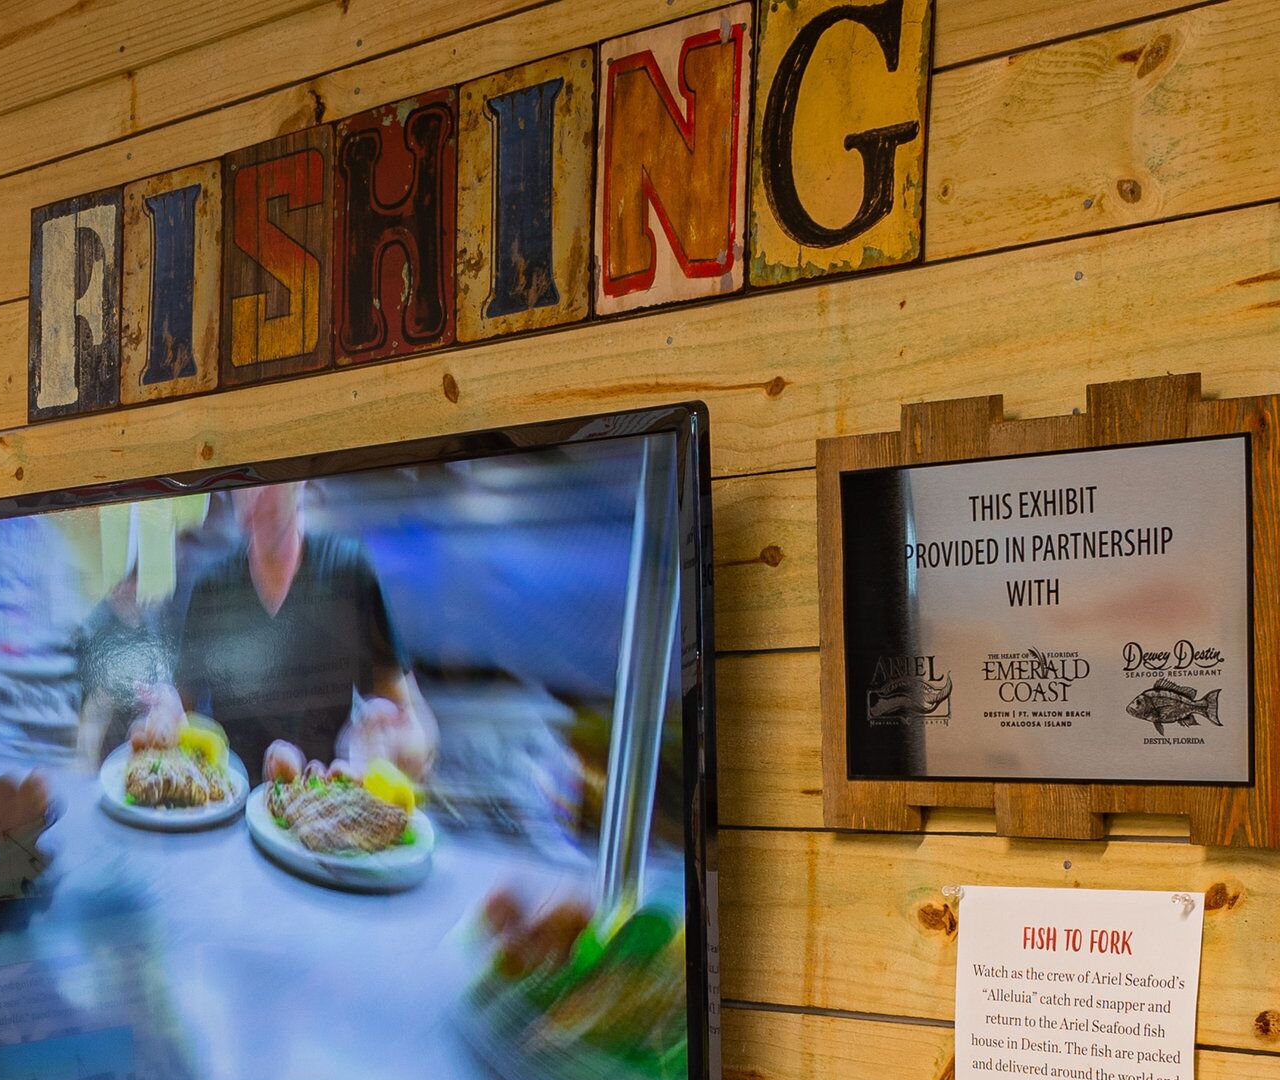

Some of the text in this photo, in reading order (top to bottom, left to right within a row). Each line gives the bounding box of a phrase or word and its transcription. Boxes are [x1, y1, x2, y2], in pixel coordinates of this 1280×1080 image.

[37, 2, 920, 411] FISHING
[968, 486, 1097, 522] THIS EXHIBIT
[904, 526, 1173, 570] PROVIDED IN PARTNERSHIP
[1006, 578, 1059, 607] WITH
[1122, 639, 1225, 672] Dewey Destin
[981, 658, 1090, 682] EMERALD
[1125, 668, 1222, 678] SEAFOOD RESTAURANT
[998, 681, 1072, 702] COAST
[1143, 737, 1172, 745] DESTIN,
[1023, 927, 1132, 955] FISH TO FORK
[973, 964, 1185, 989] Watch as the crew of Ariel Seafood's
